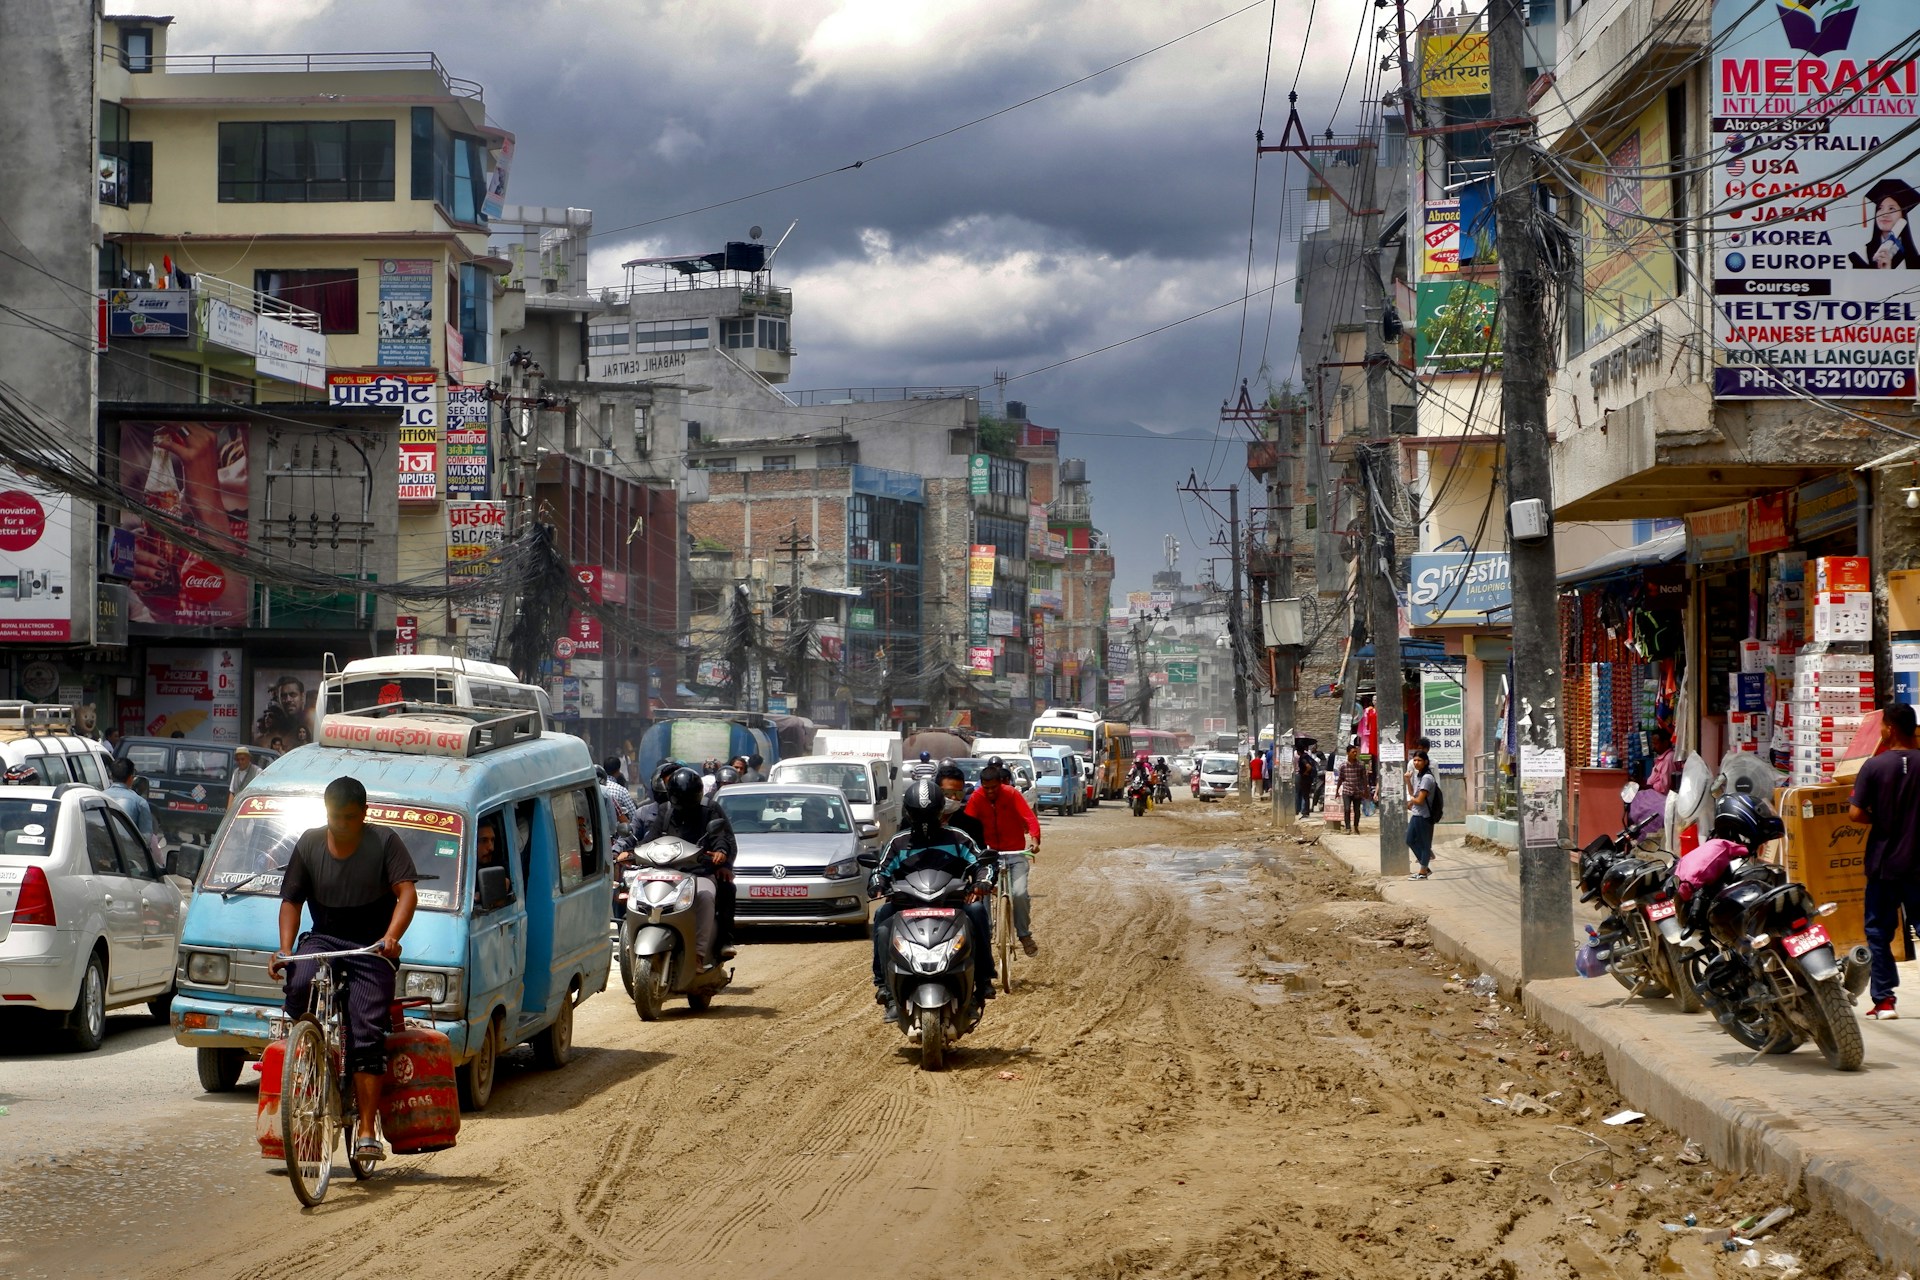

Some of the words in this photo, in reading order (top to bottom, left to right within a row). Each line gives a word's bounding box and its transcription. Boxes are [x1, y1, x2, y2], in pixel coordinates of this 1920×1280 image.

[1721, 58, 1918, 95] MERAKI
[1765, 98, 1796, 114] EDU
[1807, 97, 1916, 115] CONSULTANCY
[1723, 118, 1778, 131] Abroad
[1781, 119, 1825, 133] Study
[1752, 136, 1882, 151] AUSTRALIA
[1752, 160, 1800, 174] USA
[1752, 183, 1848, 199] CANADA
[1752, 206, 1827, 222] JAPAN
[1429, 225, 1455, 245] Free
[1752, 230, 1832, 246] KOREA
[1752, 254, 1847, 270] EUROPE
[1745, 280, 1810, 293] Courses
[1725, 301, 1917, 321] IELTS/TOFEL
[1725, 325, 1815, 343] JAPANESE
[1822, 325, 1916, 343] LANGUAGE
[1727, 349, 1807, 365] KOREAN
[1815, 349, 1916, 365] LANGUAGE
[1739, 371, 1775, 388] PH:
[1783, 370, 1906, 389] 01-5210076
[447, 456, 486, 464] COMPUTER
[448, 465, 486, 476] WILSON
[4, 517, 17, 525] for
[1660, 584, 1683, 594] Ncell
[214, 708, 238, 717] FREE
[1425, 728, 1441, 736] MBS
[1444, 728, 1461, 736] BBM
[1444, 740, 1461, 748] BCA
[1830, 857, 1866, 868] EDG
[408, 1095, 433, 1108] GAS
